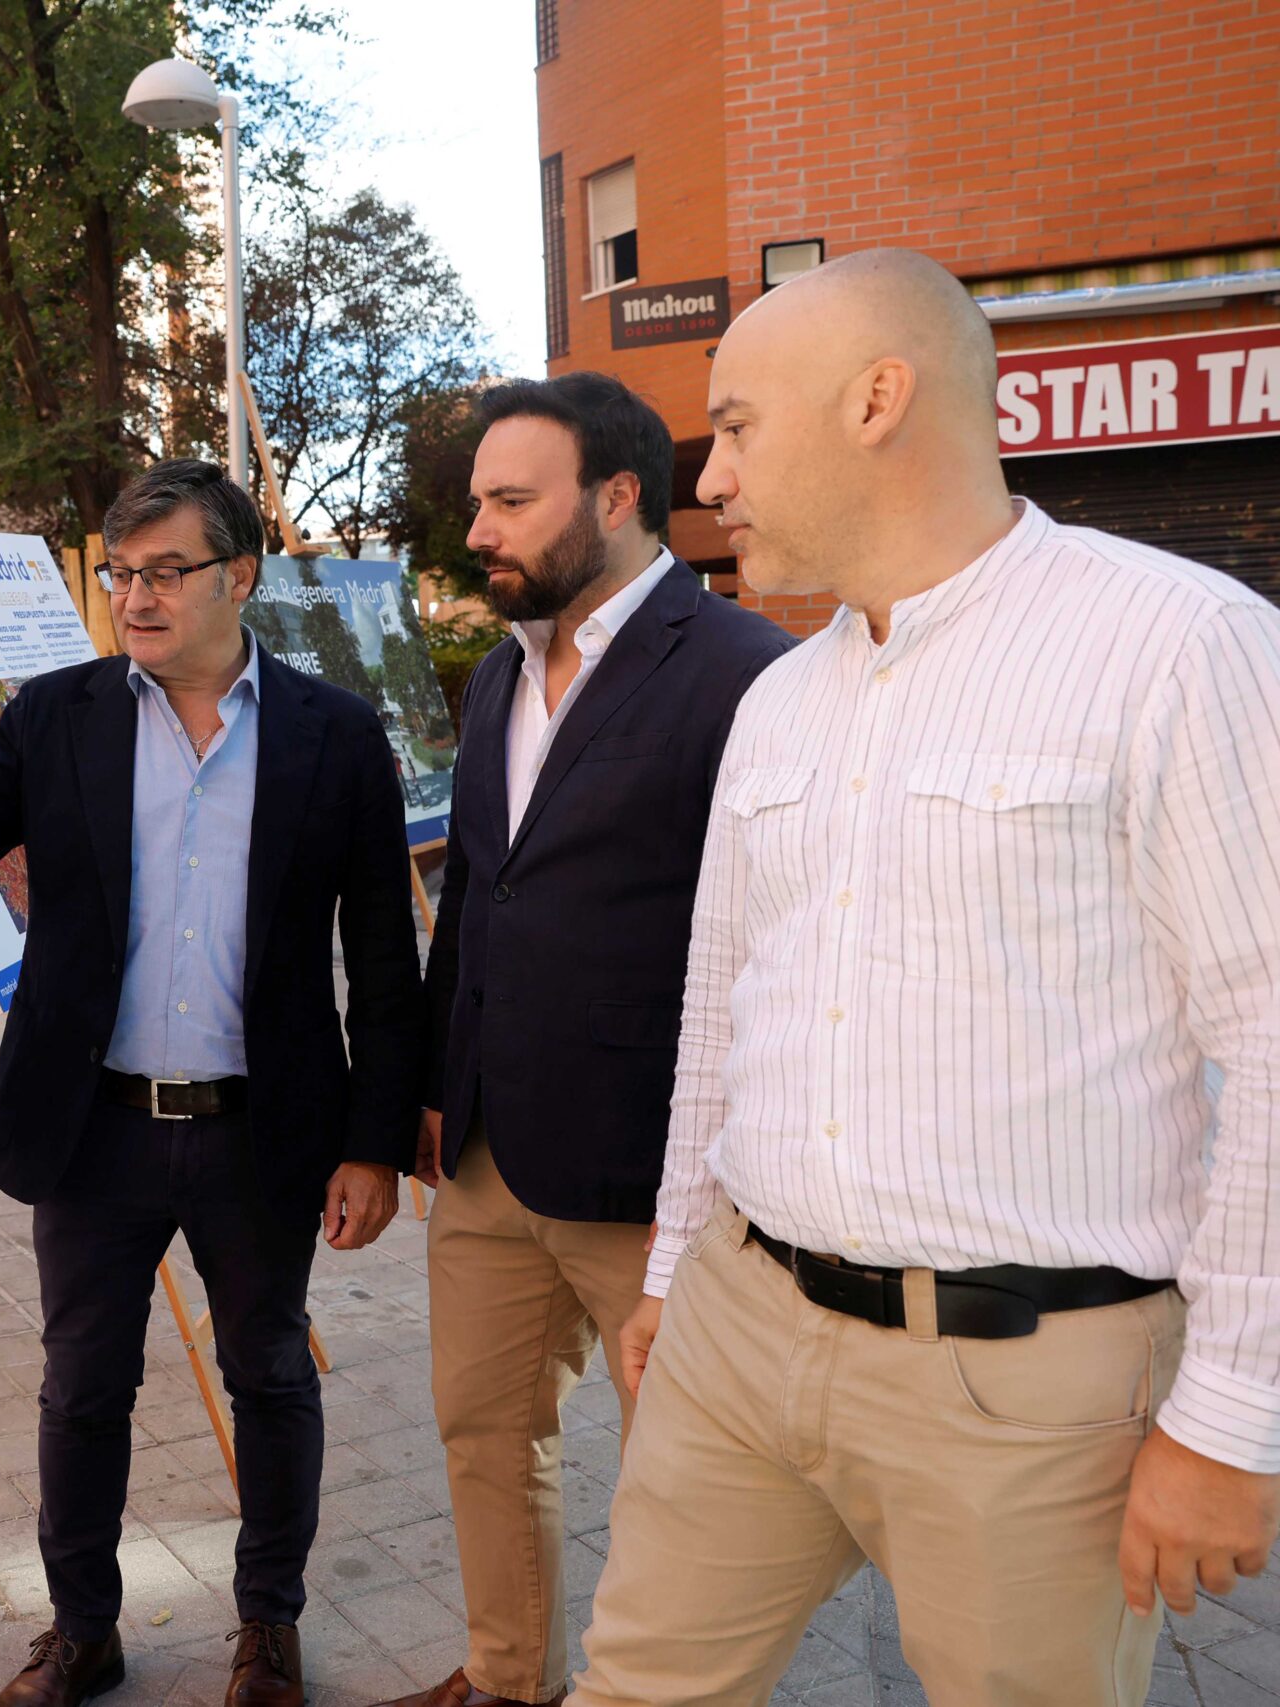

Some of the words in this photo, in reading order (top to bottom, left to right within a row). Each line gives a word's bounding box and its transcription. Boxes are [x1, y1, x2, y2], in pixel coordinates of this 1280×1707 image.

[622, 293, 716, 323] Mahou
[625, 324, 673, 338] DESDE
[996, 358, 1178, 445] STAR
[249, 584, 279, 604] lan
[278, 577, 347, 611] Regenera
[345, 579, 387, 604] Madri
[273, 651, 324, 675] UBRE
[0, 978, 18, 998] madrid
